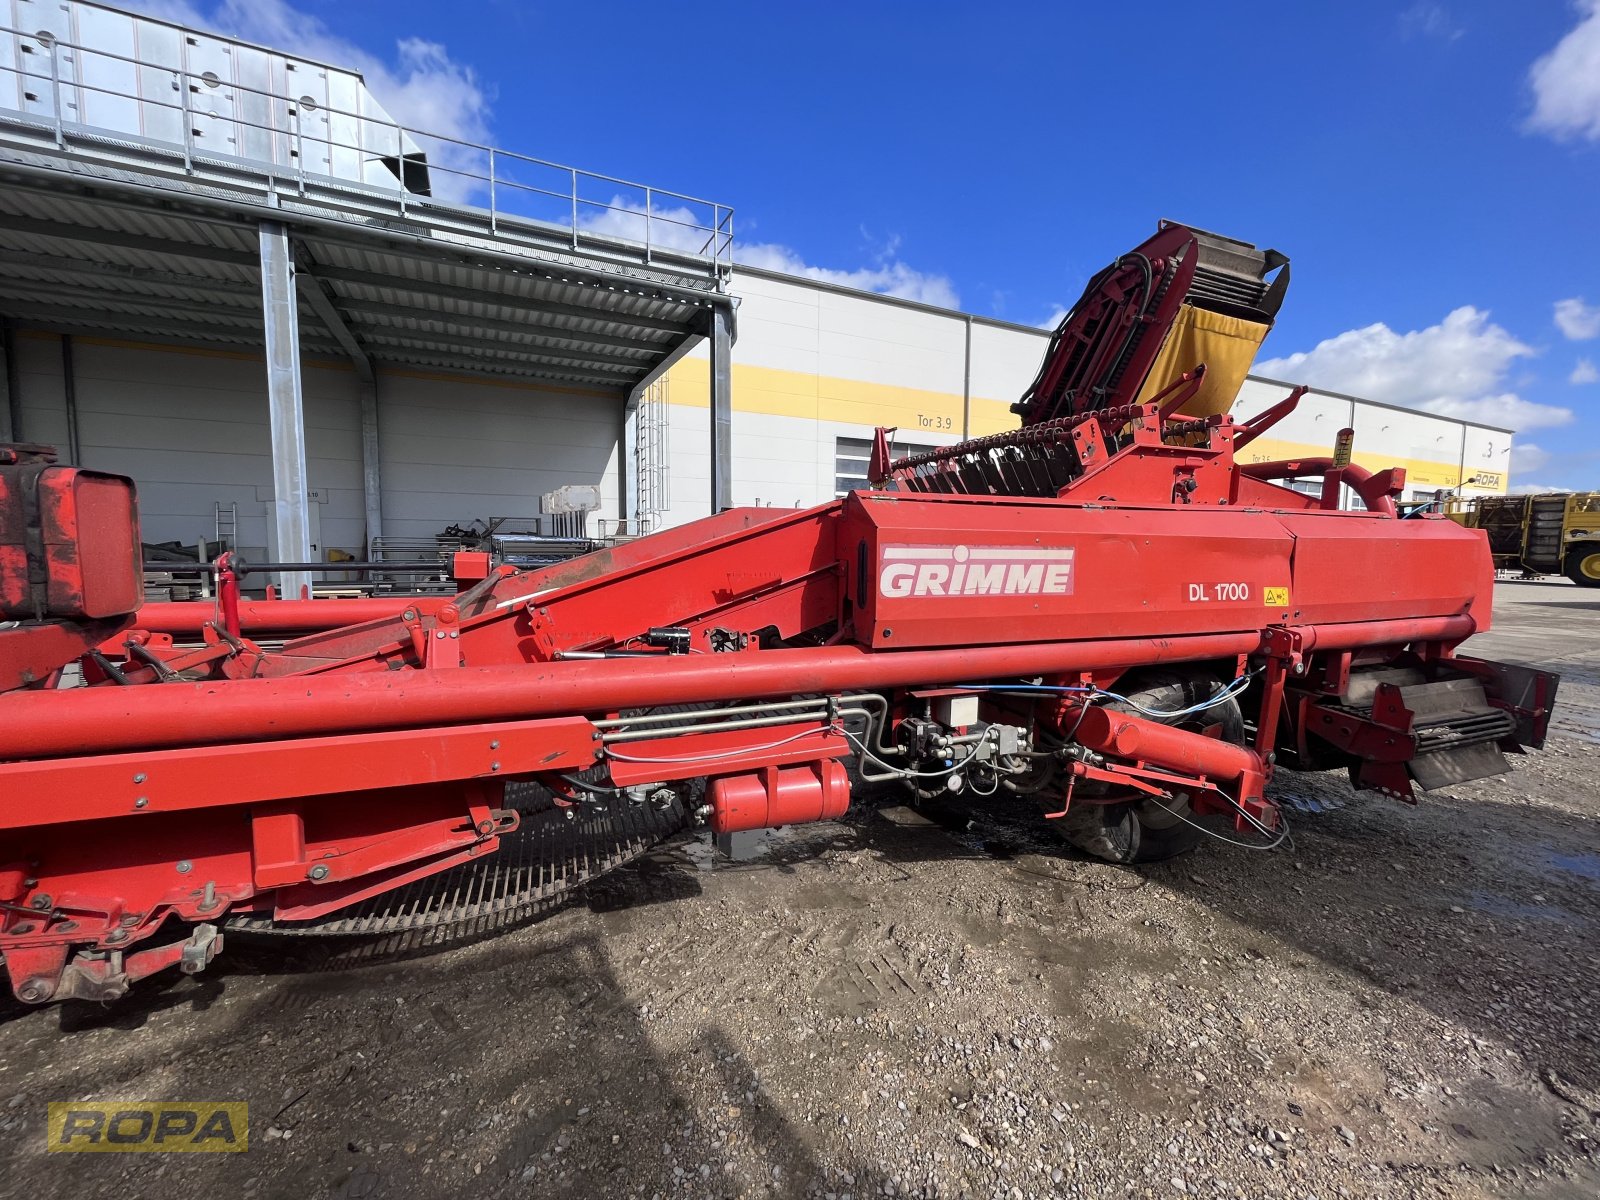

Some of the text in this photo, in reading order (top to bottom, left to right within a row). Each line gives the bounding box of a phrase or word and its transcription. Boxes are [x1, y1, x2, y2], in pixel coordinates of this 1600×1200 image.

[917, 414, 952, 430] Tor 3.9
[1475, 474, 1499, 487] ROPA
[880, 546, 1073, 598] GRIMME
[1189, 583, 1249, 601] DL 1700
